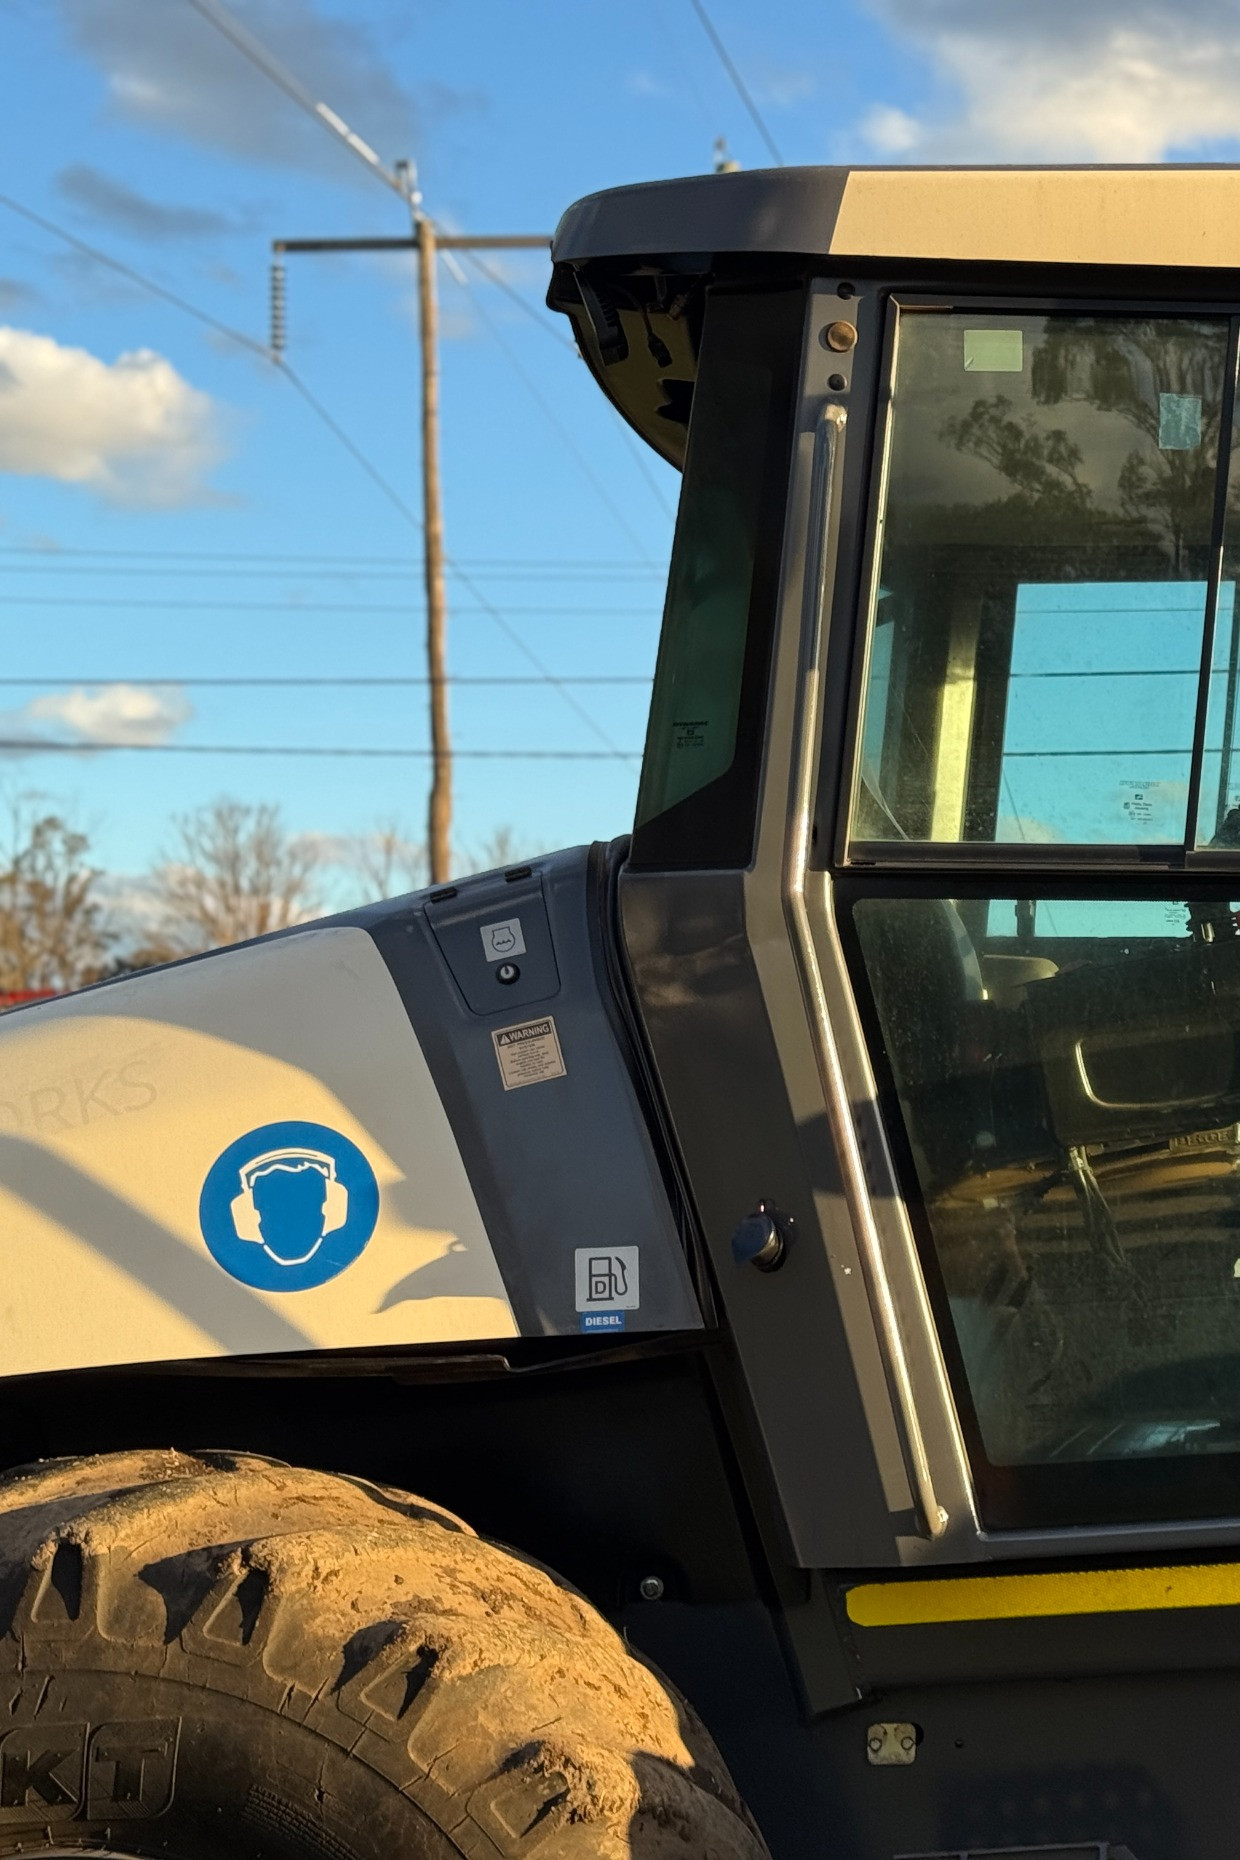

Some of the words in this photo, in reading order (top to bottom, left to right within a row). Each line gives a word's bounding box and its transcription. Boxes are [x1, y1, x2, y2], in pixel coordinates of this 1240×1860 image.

[508, 1024, 550, 1041] WARNING
[594, 1280, 607, 1295] D
[585, 1315, 622, 1327] DIESEL
[0, 1736, 176, 1812] KT
